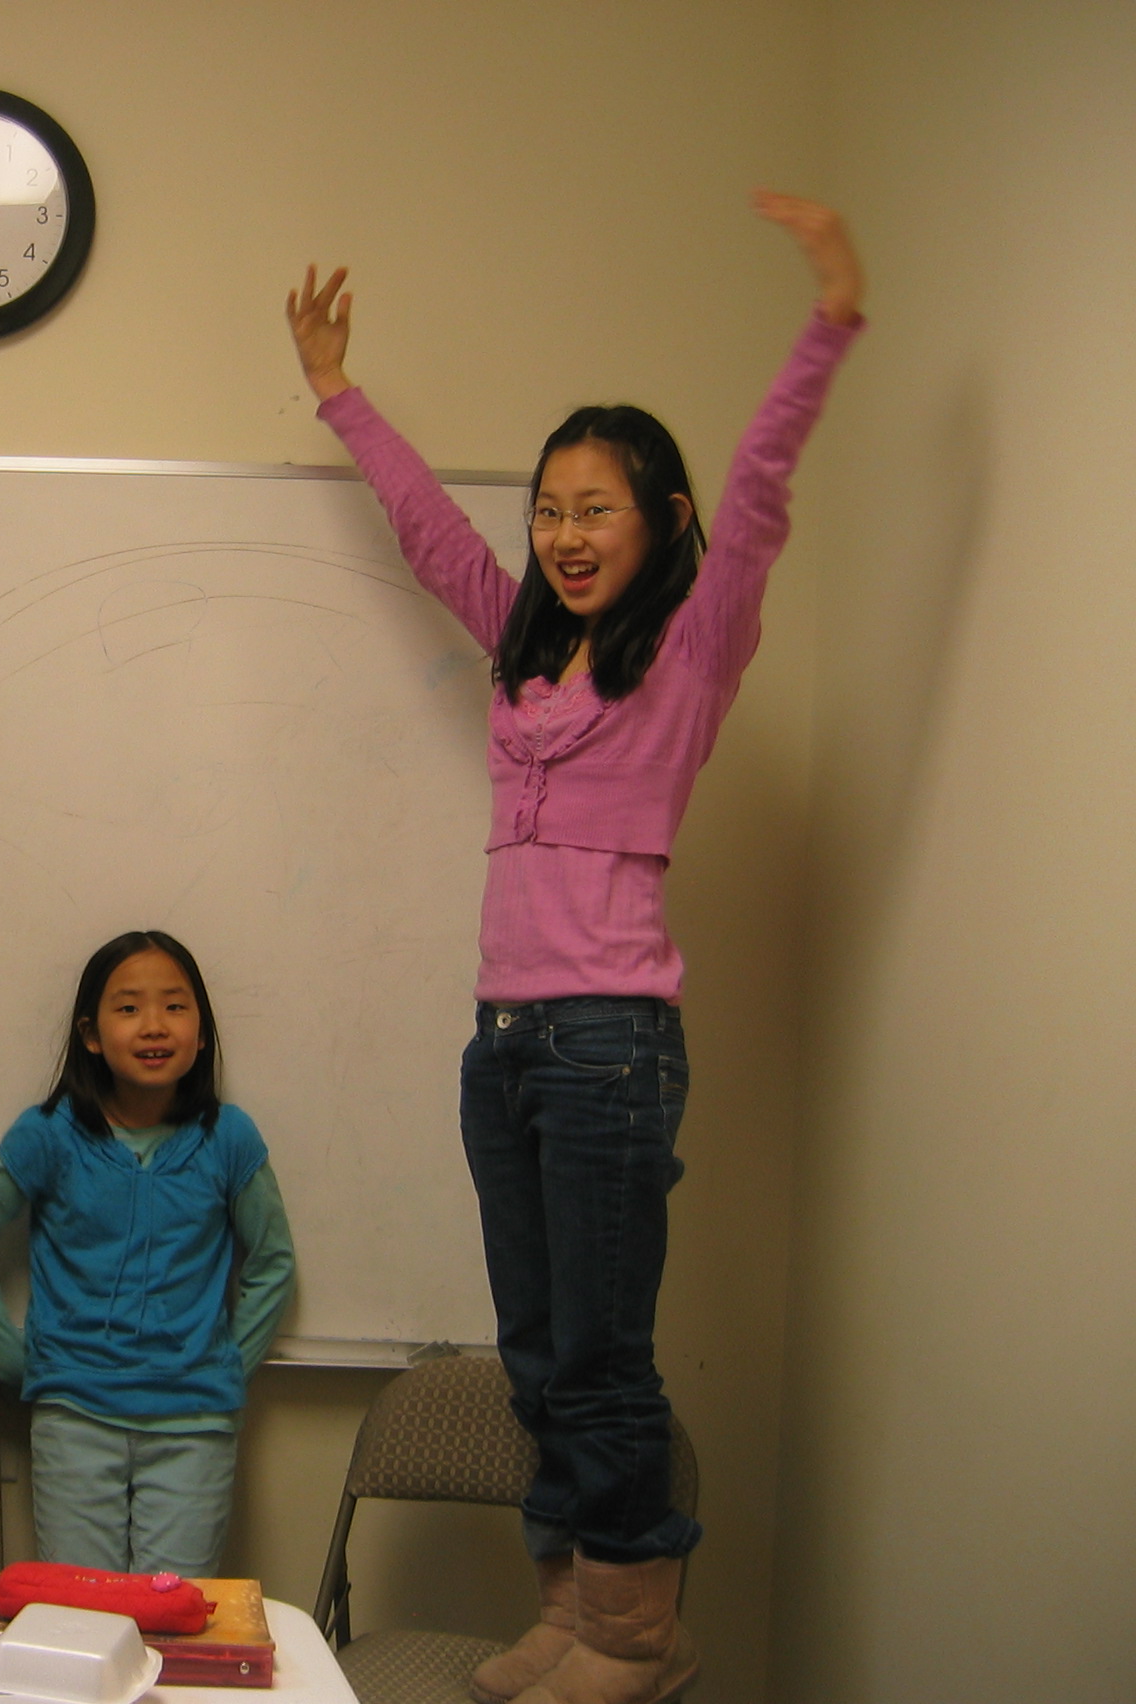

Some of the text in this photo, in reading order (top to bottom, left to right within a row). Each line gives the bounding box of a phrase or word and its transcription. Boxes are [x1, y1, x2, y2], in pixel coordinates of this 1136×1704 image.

[6, 144, 13, 162] 1
[26, 168, 39, 187] 2
[36, 205, 49, 225] 3
[22, 242, 36, 262] 4
